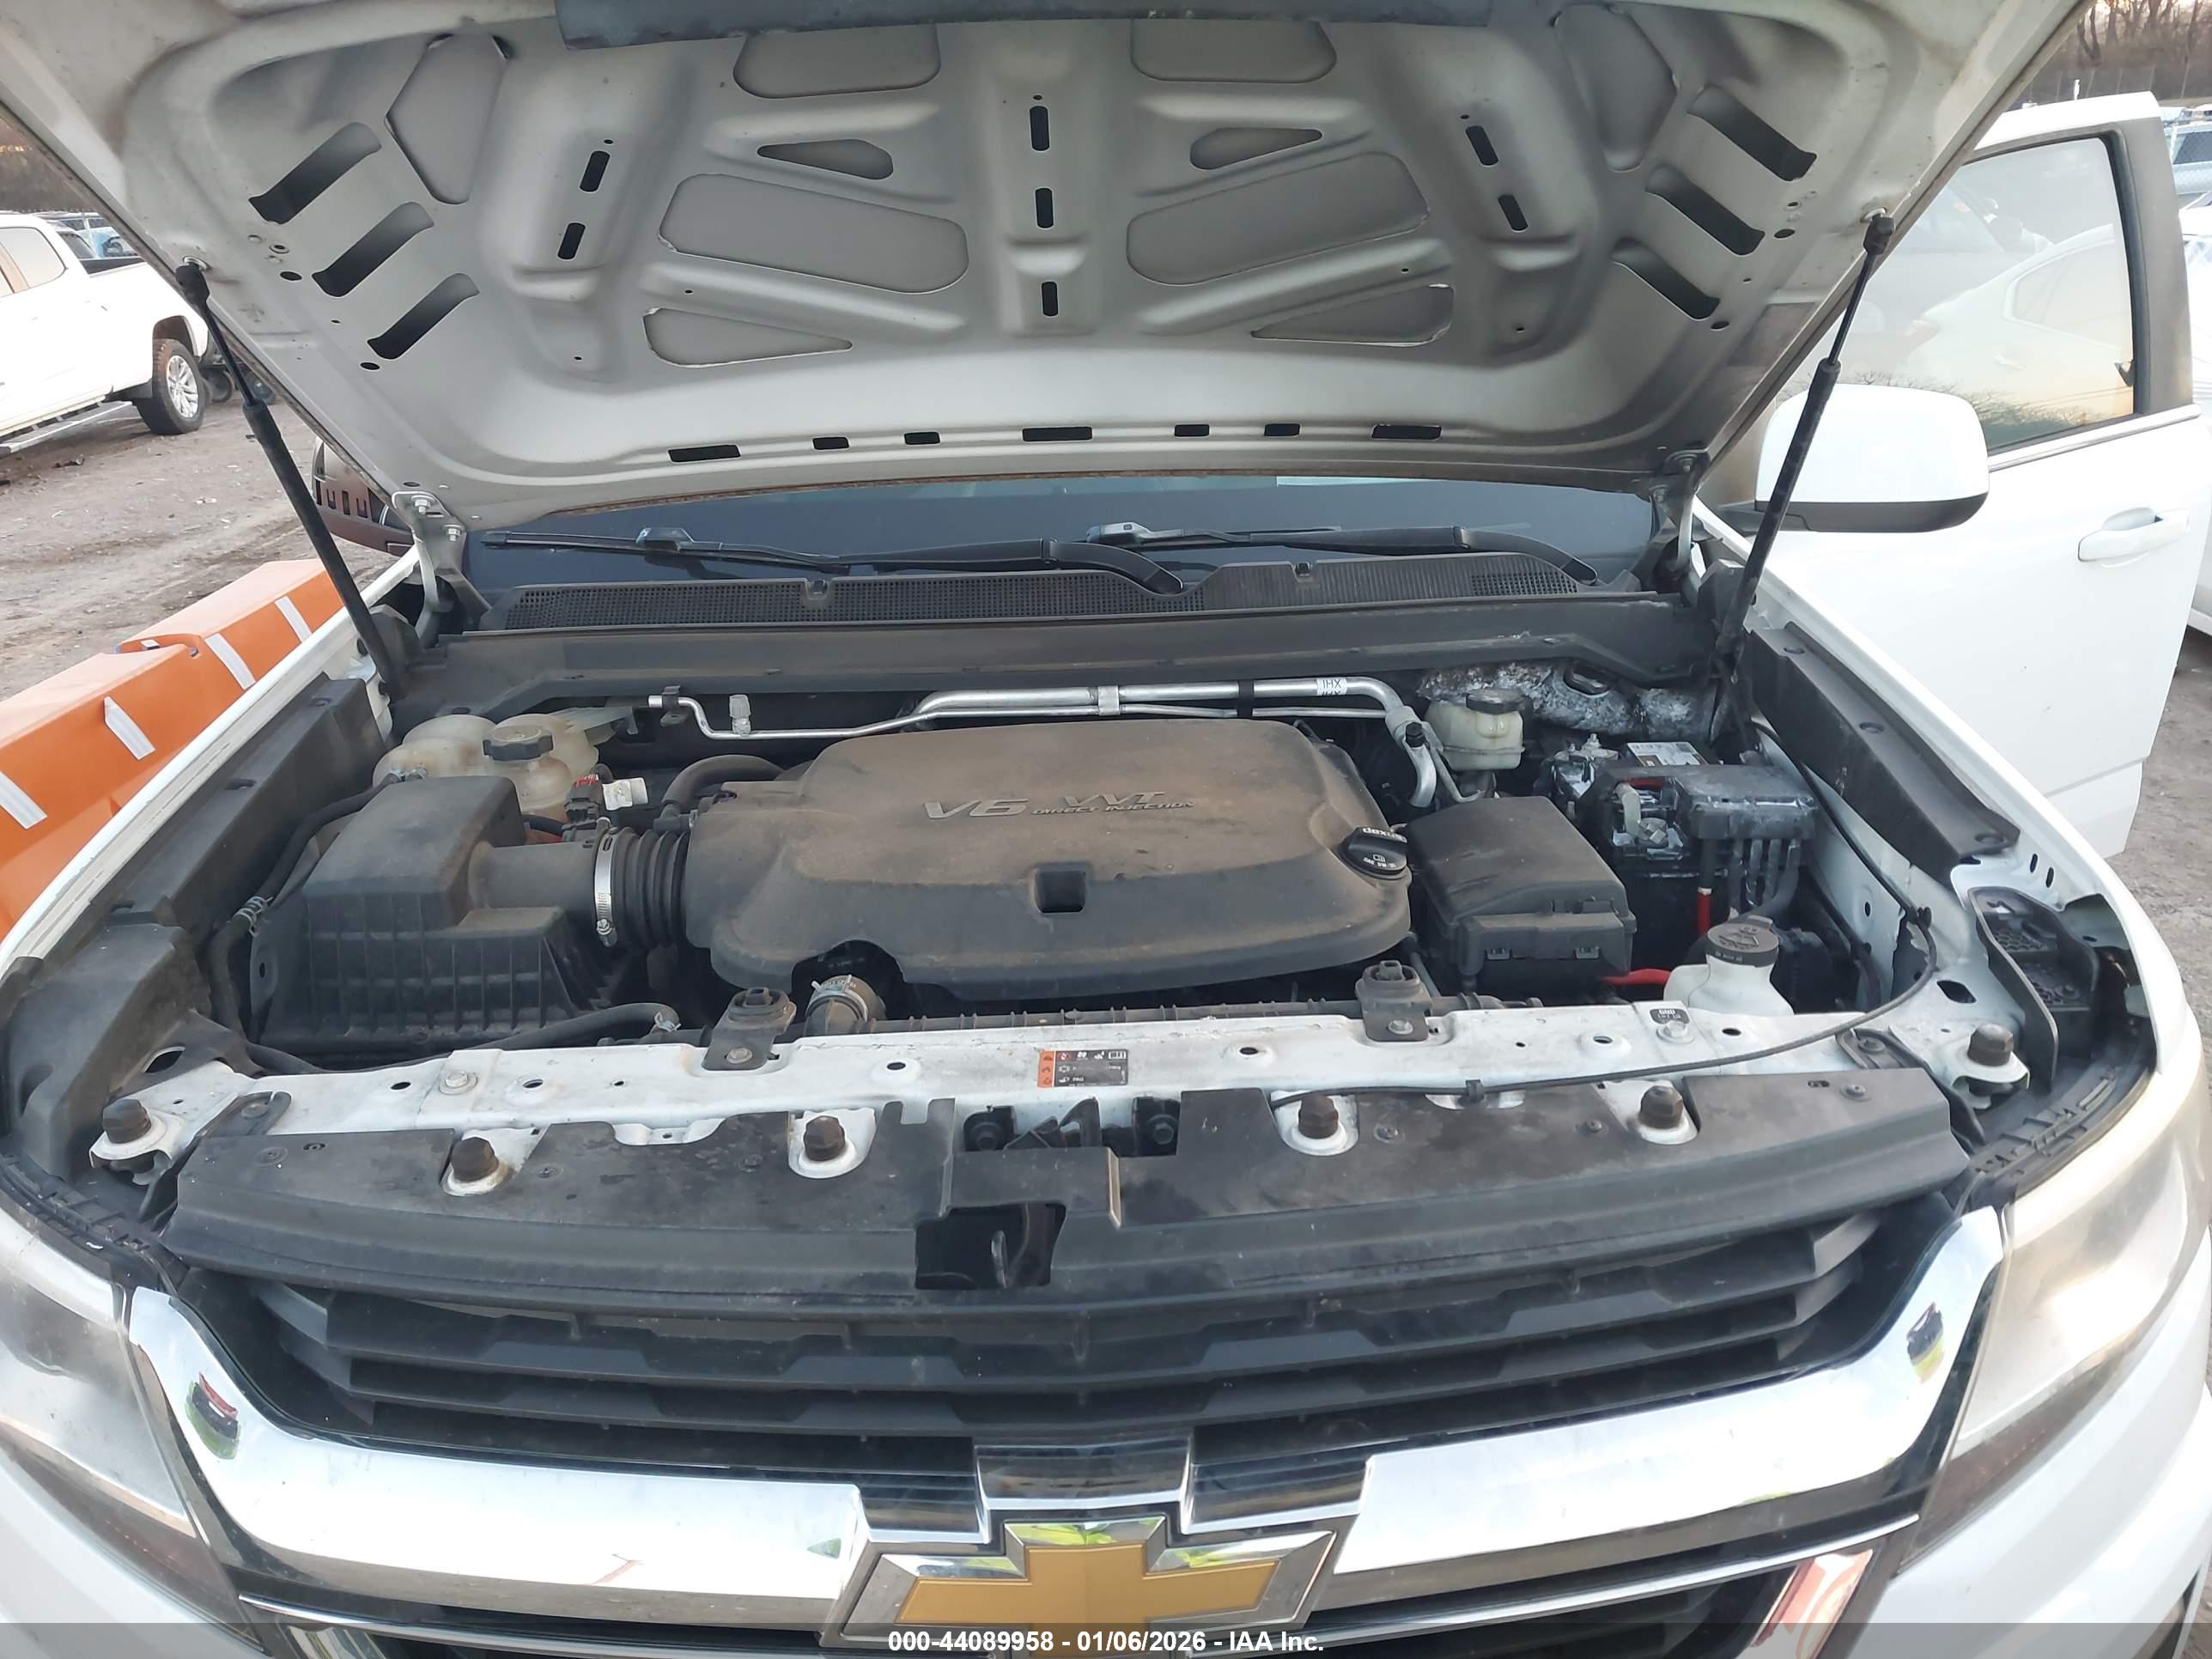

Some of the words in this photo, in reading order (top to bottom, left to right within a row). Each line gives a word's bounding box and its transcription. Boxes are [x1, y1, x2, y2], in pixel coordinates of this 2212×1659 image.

[1064, 791, 1165, 807] VVT
[922, 798, 1029, 819] V6
[1031, 805, 1099, 815] DIRECT
[1105, 801, 1196, 812] INJECTION
